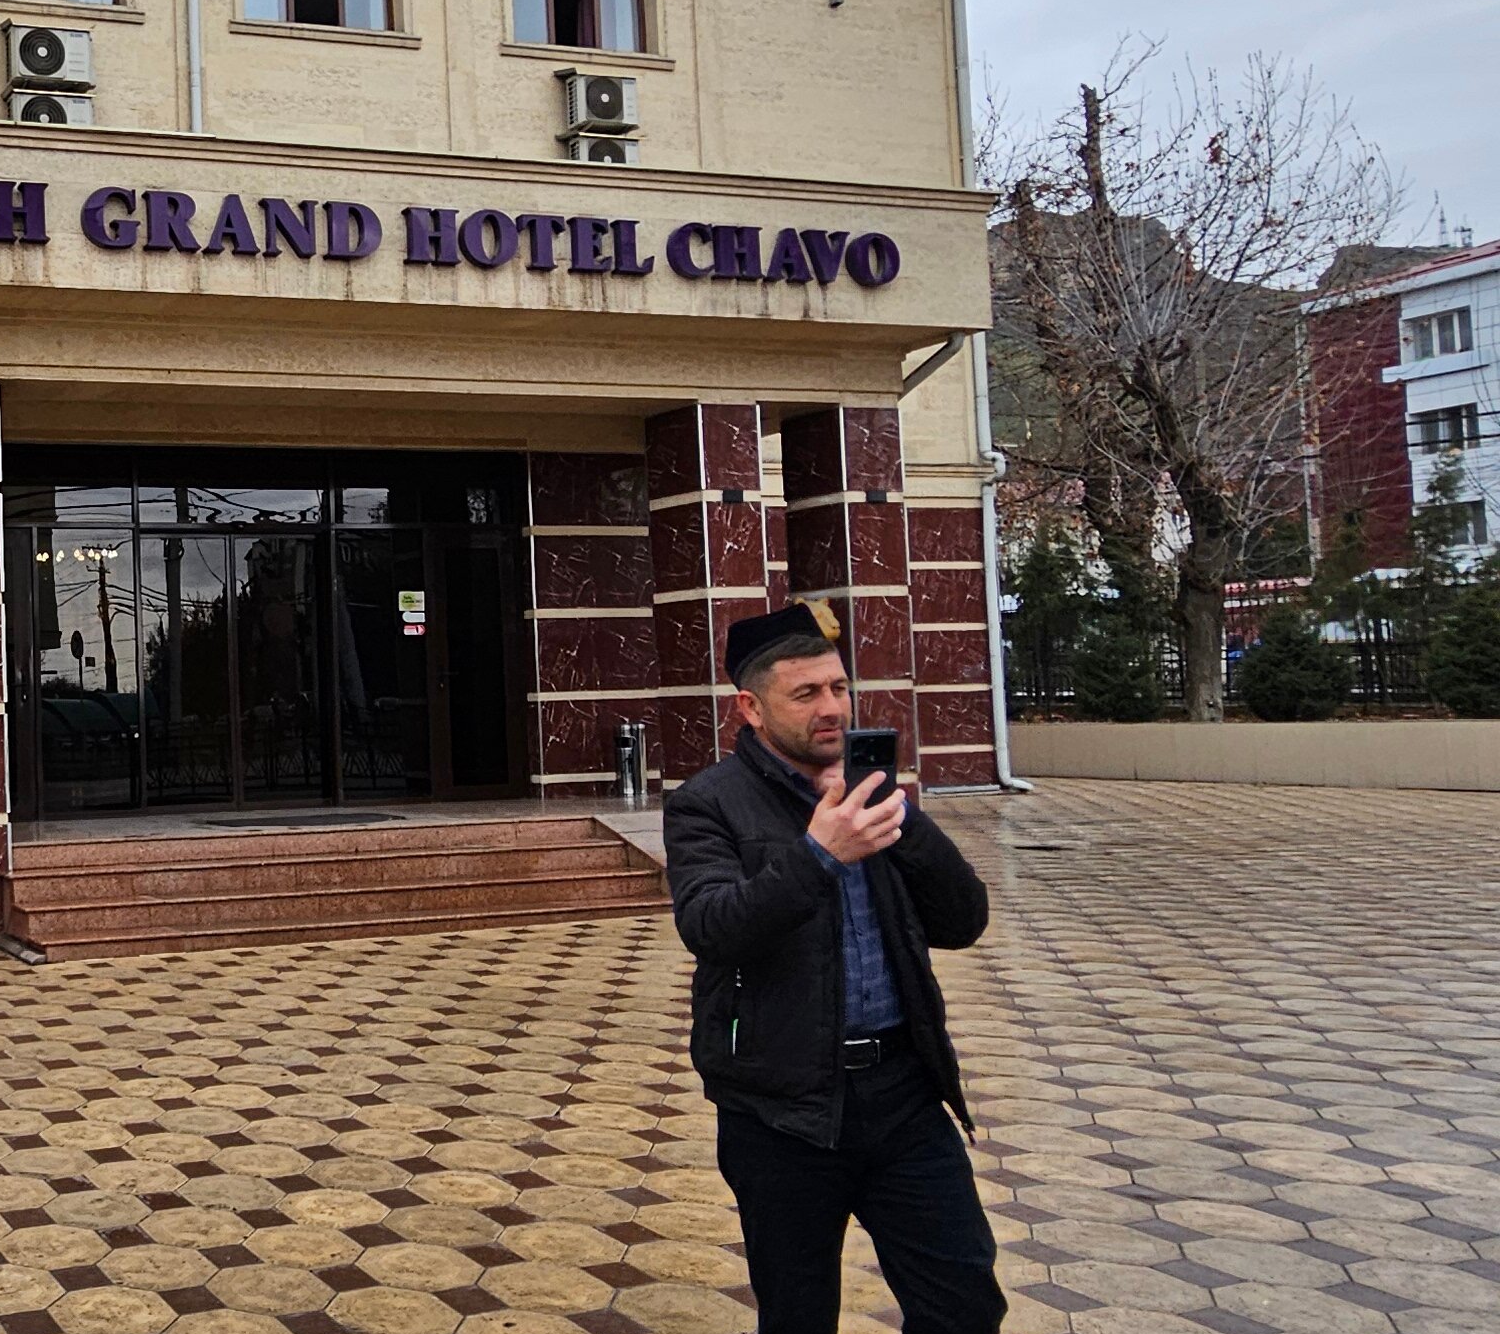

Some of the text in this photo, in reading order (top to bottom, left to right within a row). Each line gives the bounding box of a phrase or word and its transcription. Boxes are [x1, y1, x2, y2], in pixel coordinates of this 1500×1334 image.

[80, 186, 383, 261] GRAND
[401, 206, 655, 276] HOTEL
[666, 222, 900, 288] CHAVO
